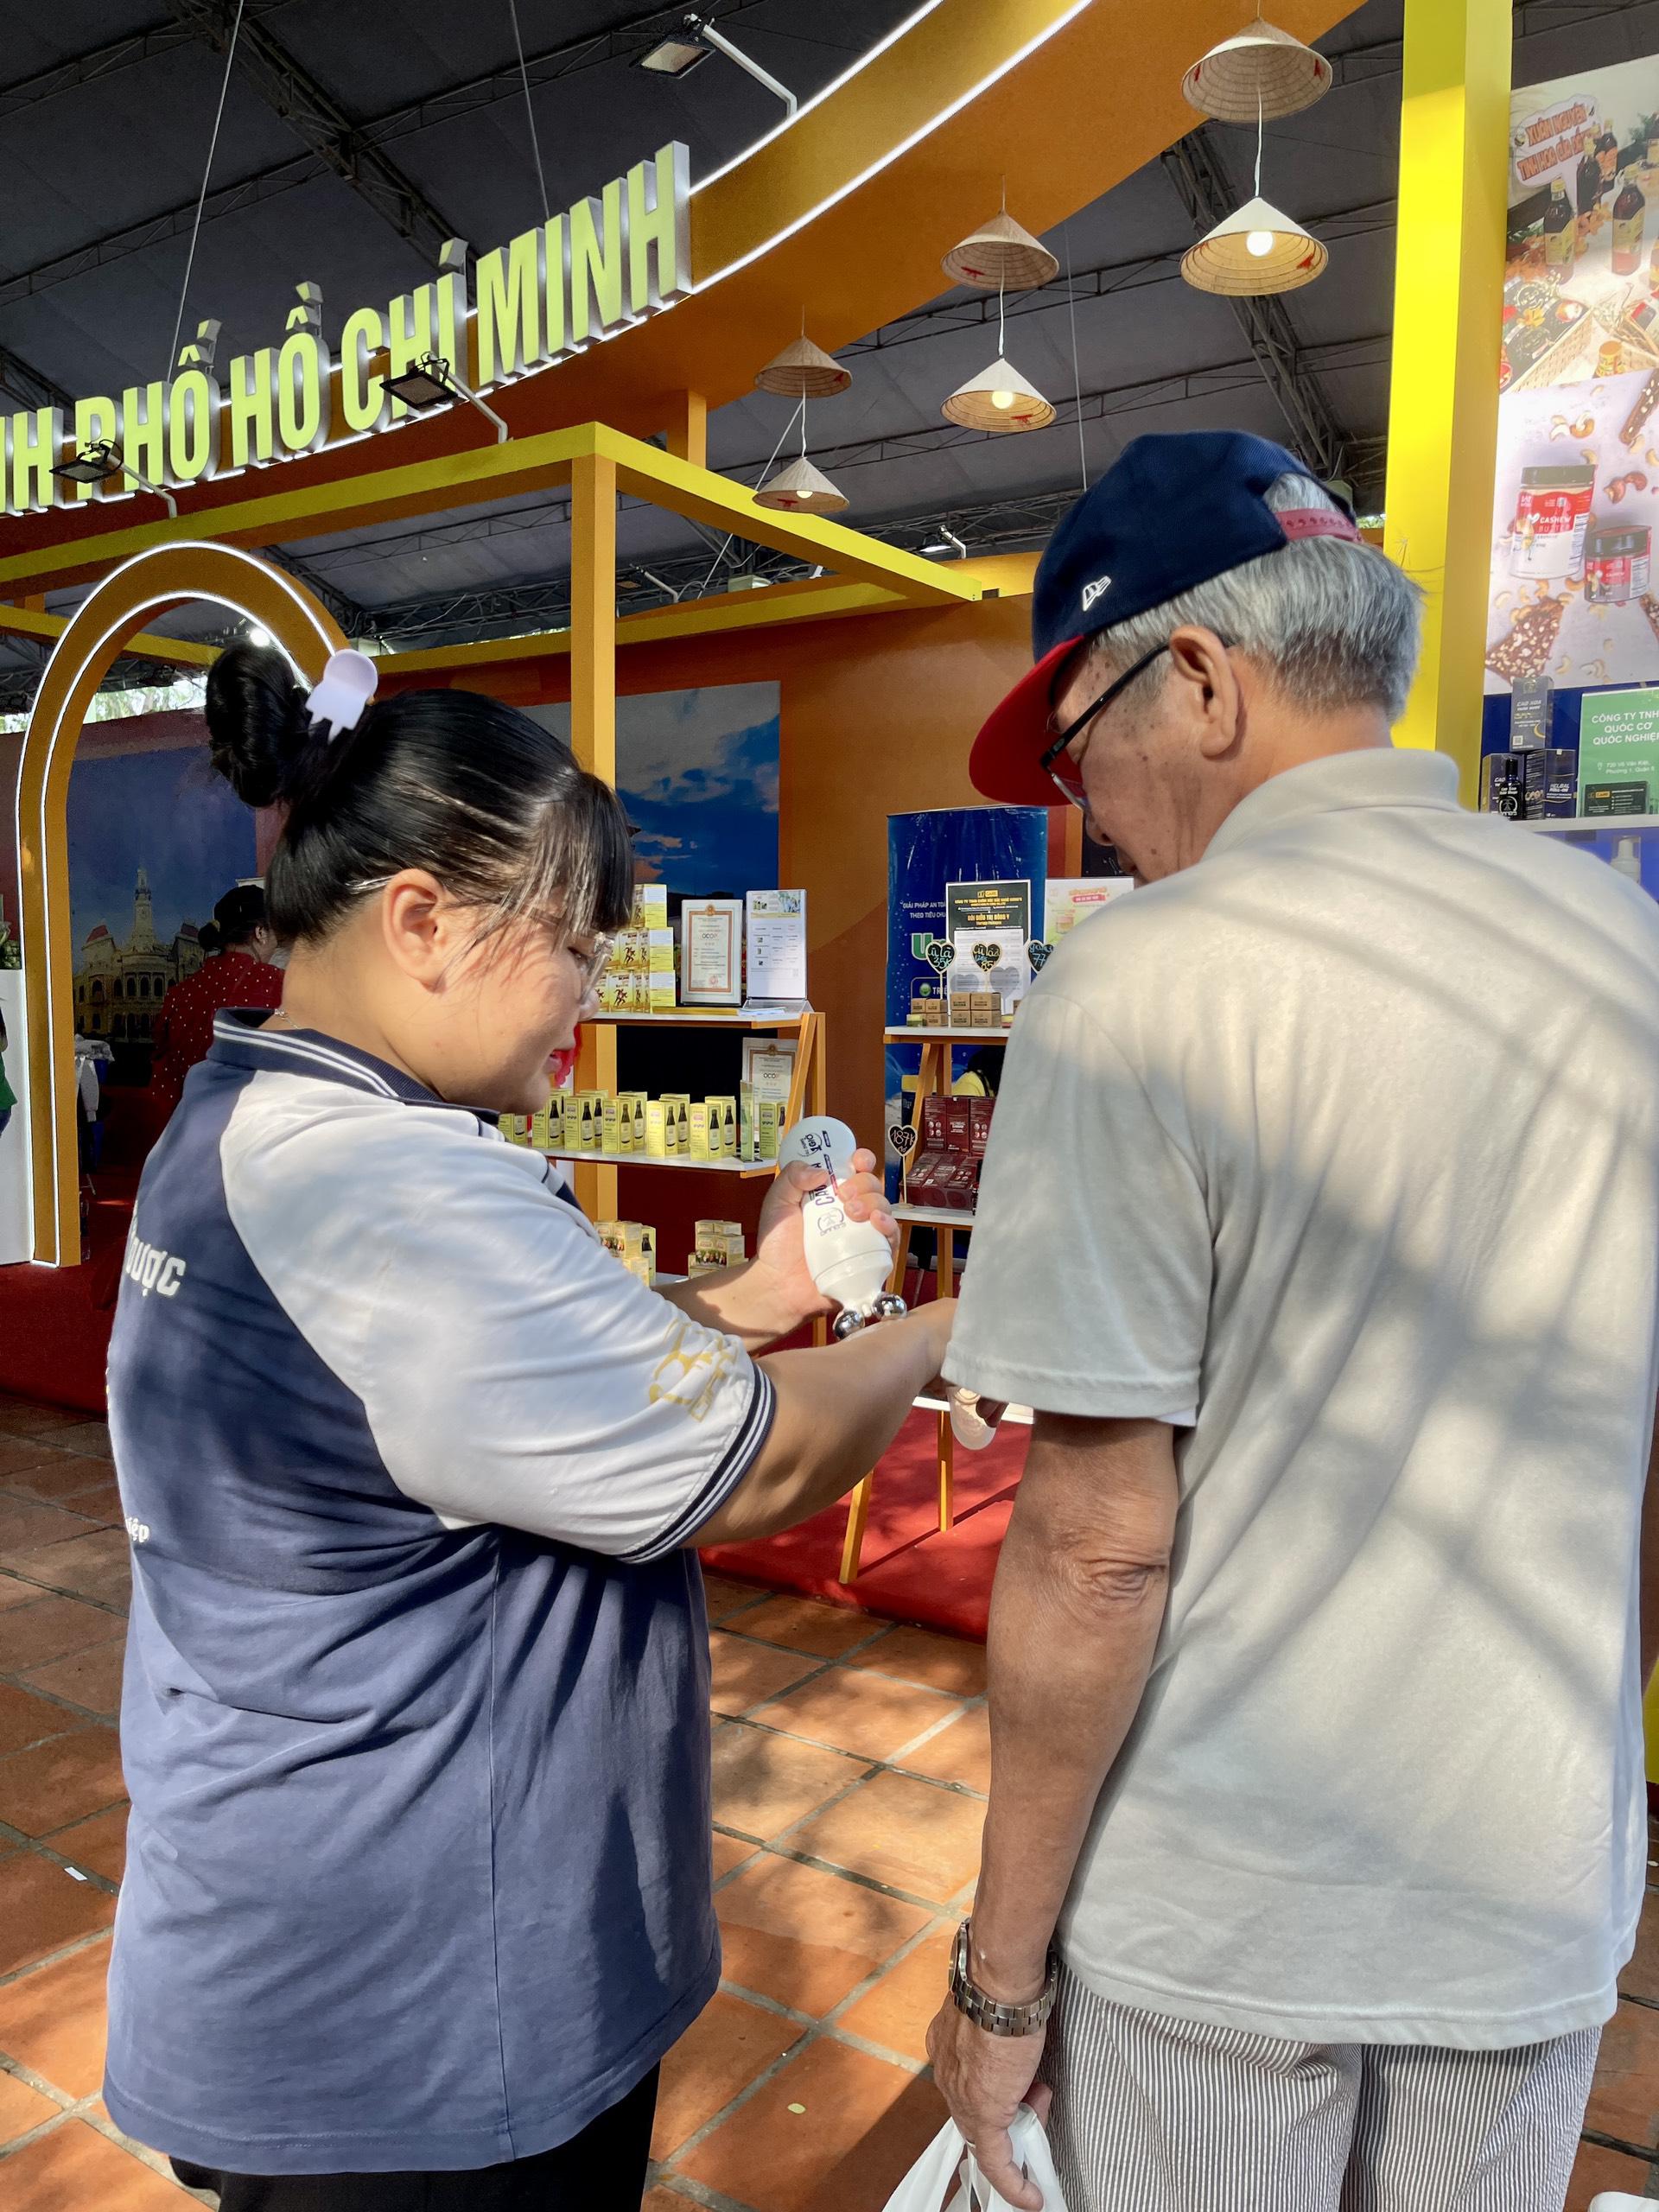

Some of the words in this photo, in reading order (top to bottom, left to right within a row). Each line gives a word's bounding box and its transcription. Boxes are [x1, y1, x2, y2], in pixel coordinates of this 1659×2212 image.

[341, 237, 469, 433] CHÍ
[476, 140, 691, 389] MINH
[1592, 713, 1621, 724] CÔNG
[1624, 711, 1637, 721] TY
[1637, 721, 1653, 731] CƠ
